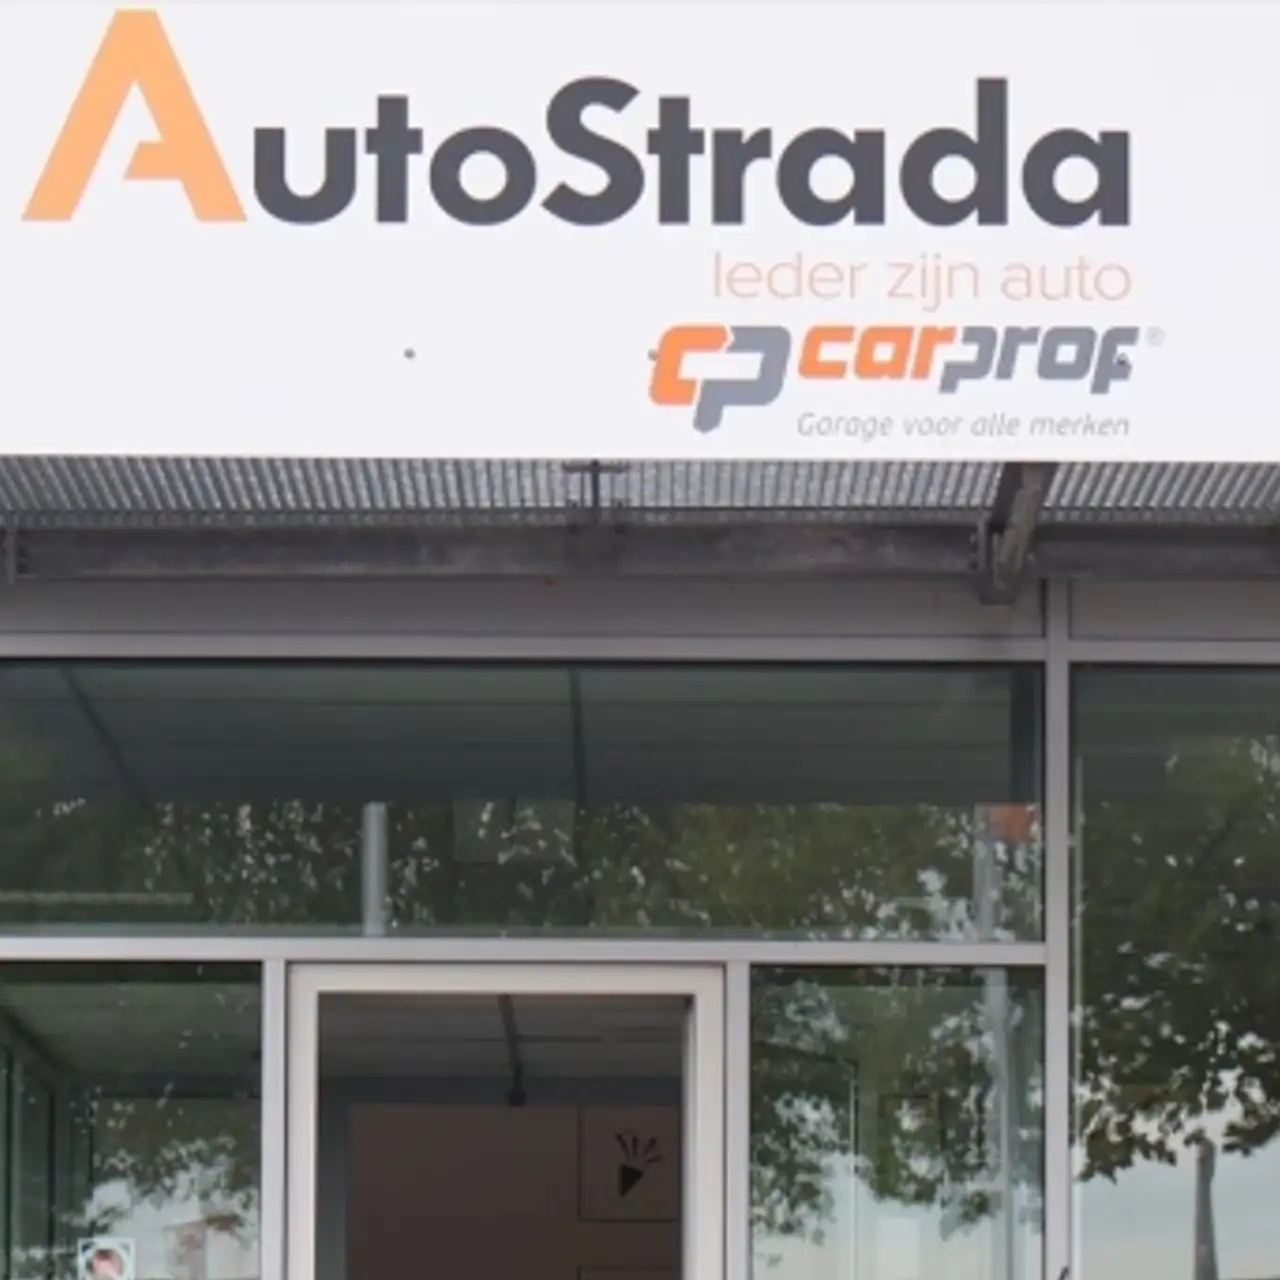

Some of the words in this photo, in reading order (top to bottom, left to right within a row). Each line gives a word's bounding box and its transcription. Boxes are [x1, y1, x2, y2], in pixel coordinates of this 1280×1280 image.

[22, 8, 1132, 229] AutoStrada
[713, 252, 868, 301] Ieder
[886, 253, 980, 313] zijn
[1000, 256, 1133, 302] auto
[797, 412, 893, 443] Garage
[904, 416, 963, 437] voor
[970, 412, 1020, 437] alle
[1029, 413, 1130, 437] merken
